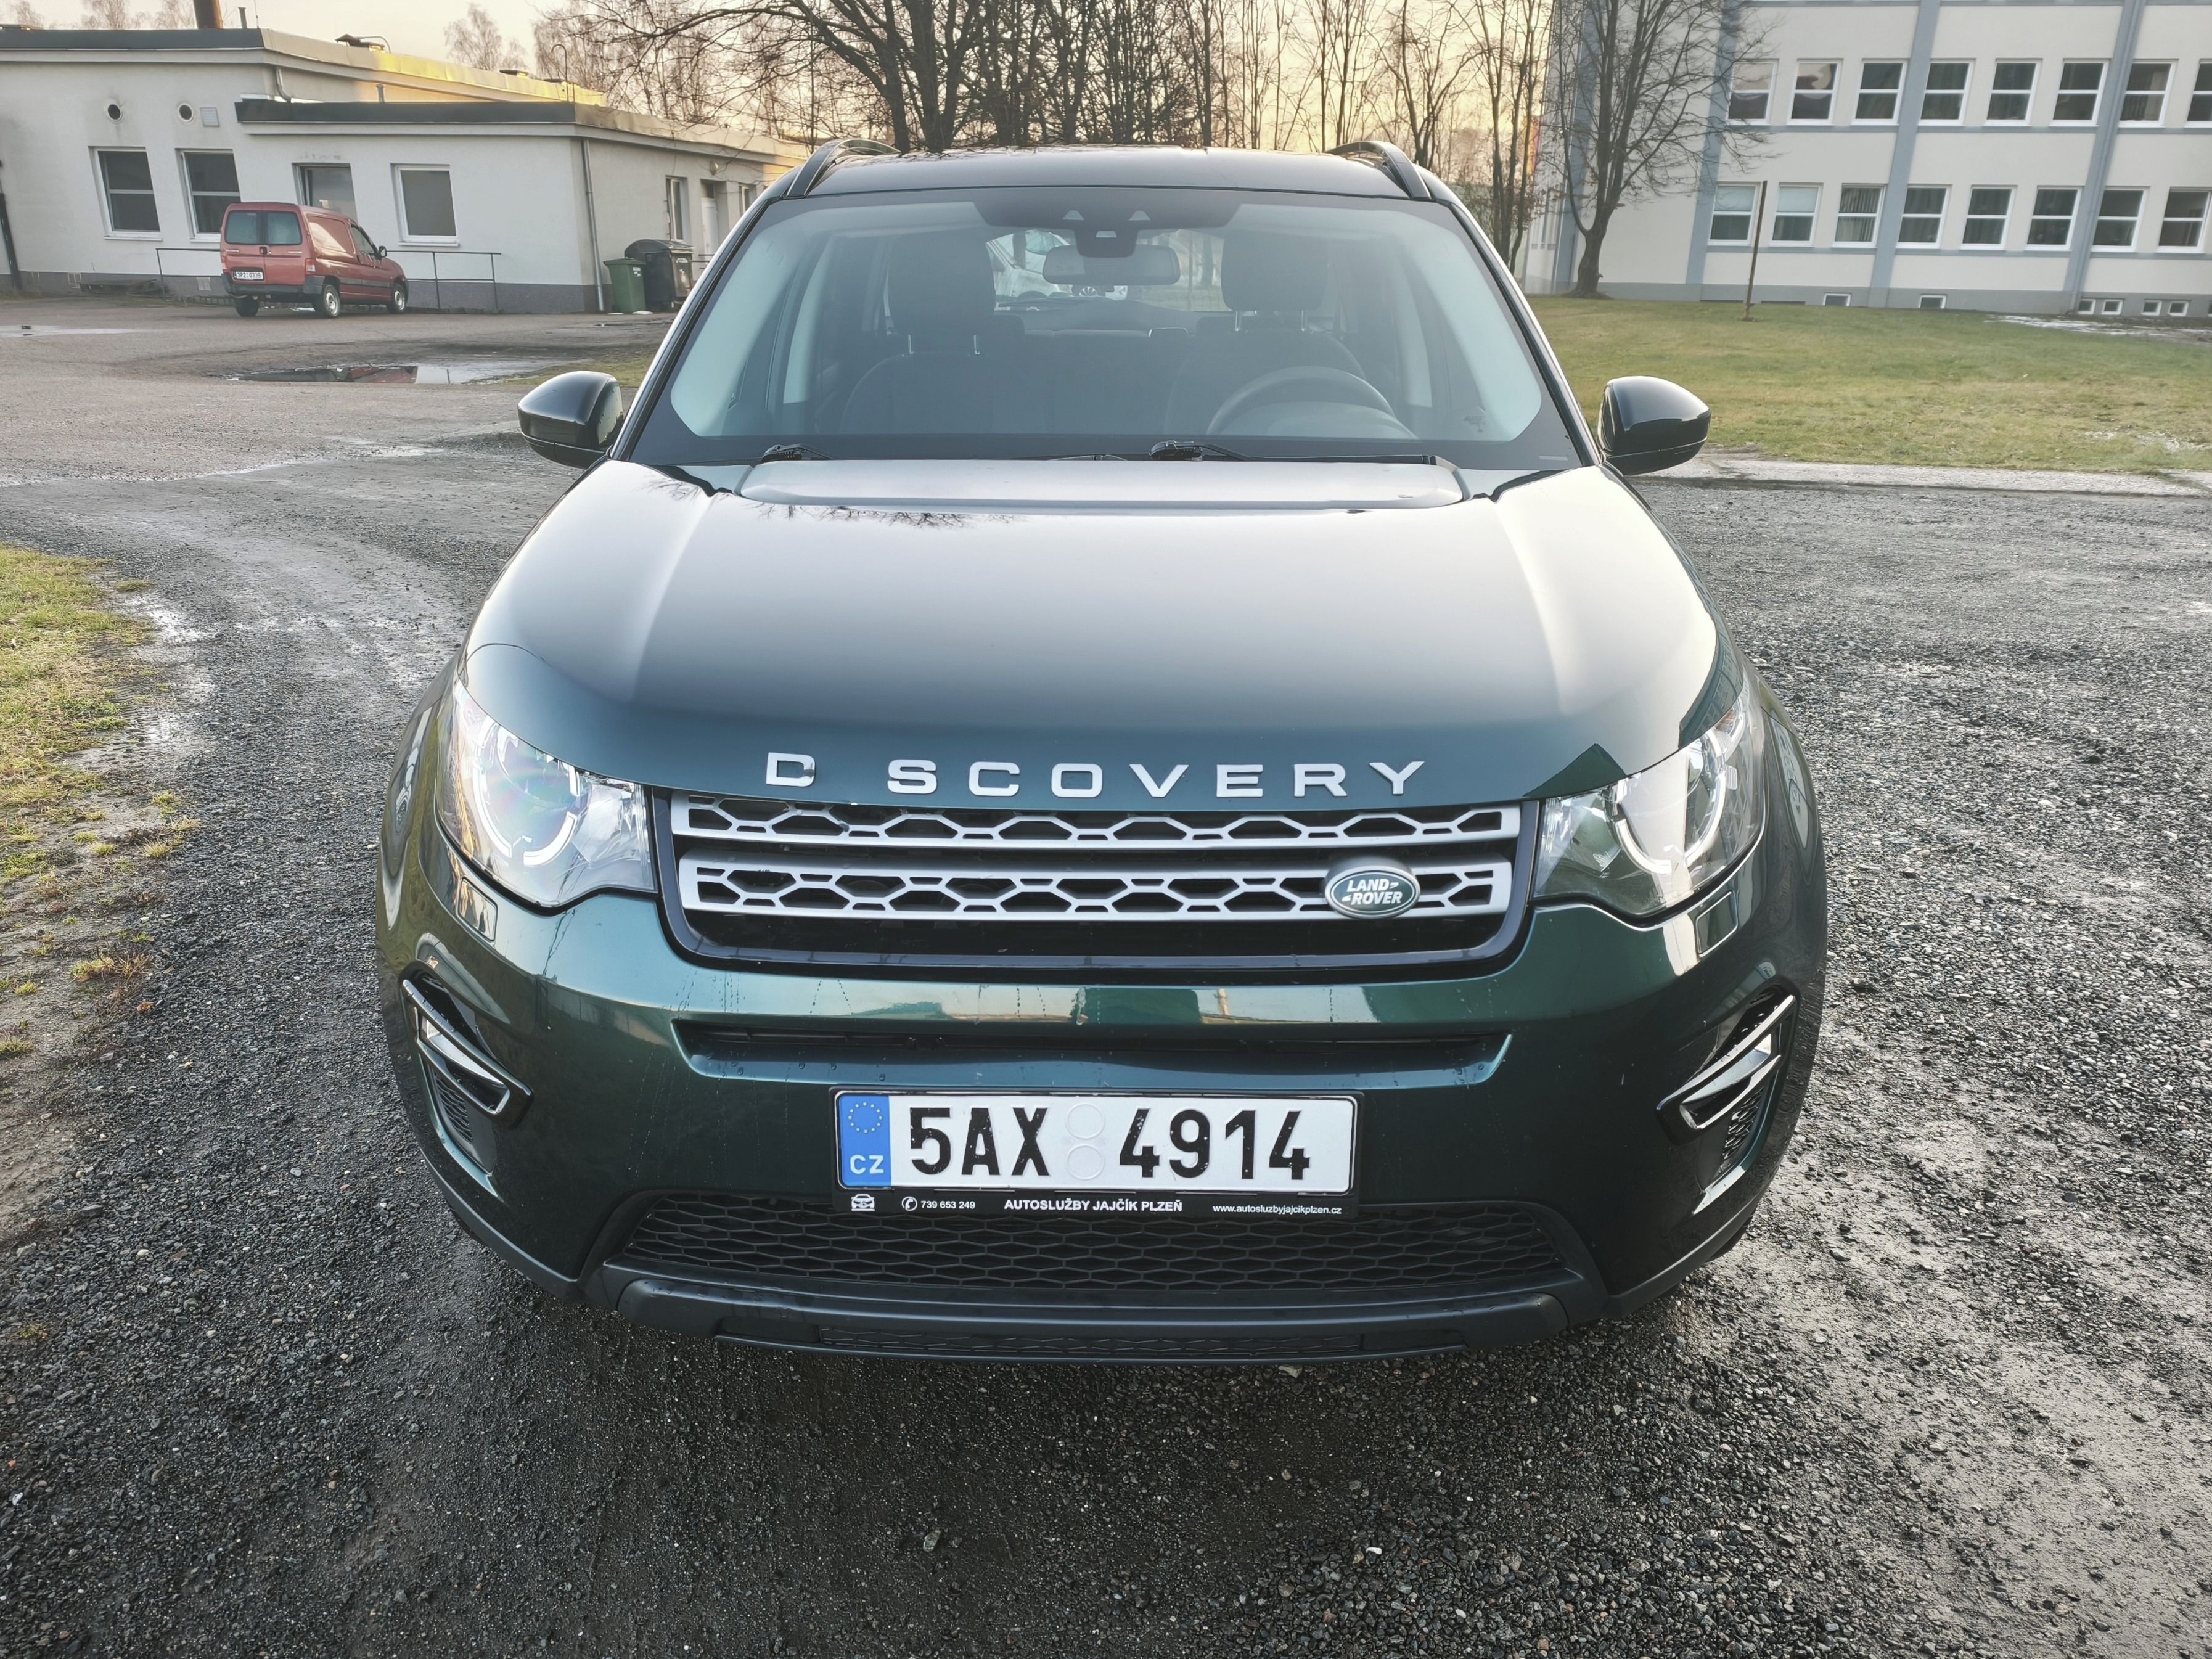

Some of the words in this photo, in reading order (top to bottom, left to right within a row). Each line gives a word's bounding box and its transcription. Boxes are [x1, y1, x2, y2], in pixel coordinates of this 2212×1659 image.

[1346, 879, 1390, 892] LAND
[1351, 891, 1403, 906] ROVER
[910, 1107, 1050, 1176] 5AX
[1119, 1108, 1311, 1181] 4914
[850, 1154, 884, 1174] CZ
[920, 1200, 937, 1209] 739
[940, 1200, 956, 1209] 653
[959, 1201, 976, 1210] 249
[1004, 1198, 1090, 1211] AUTOSLUŽBY
[1092, 1198, 1138, 1212] JAJČÍK
[1141, 1200, 1182, 1212] PLZEŇ
[1212, 1205, 1342, 1215] www.autosluzbyjajcikplzen.cz
